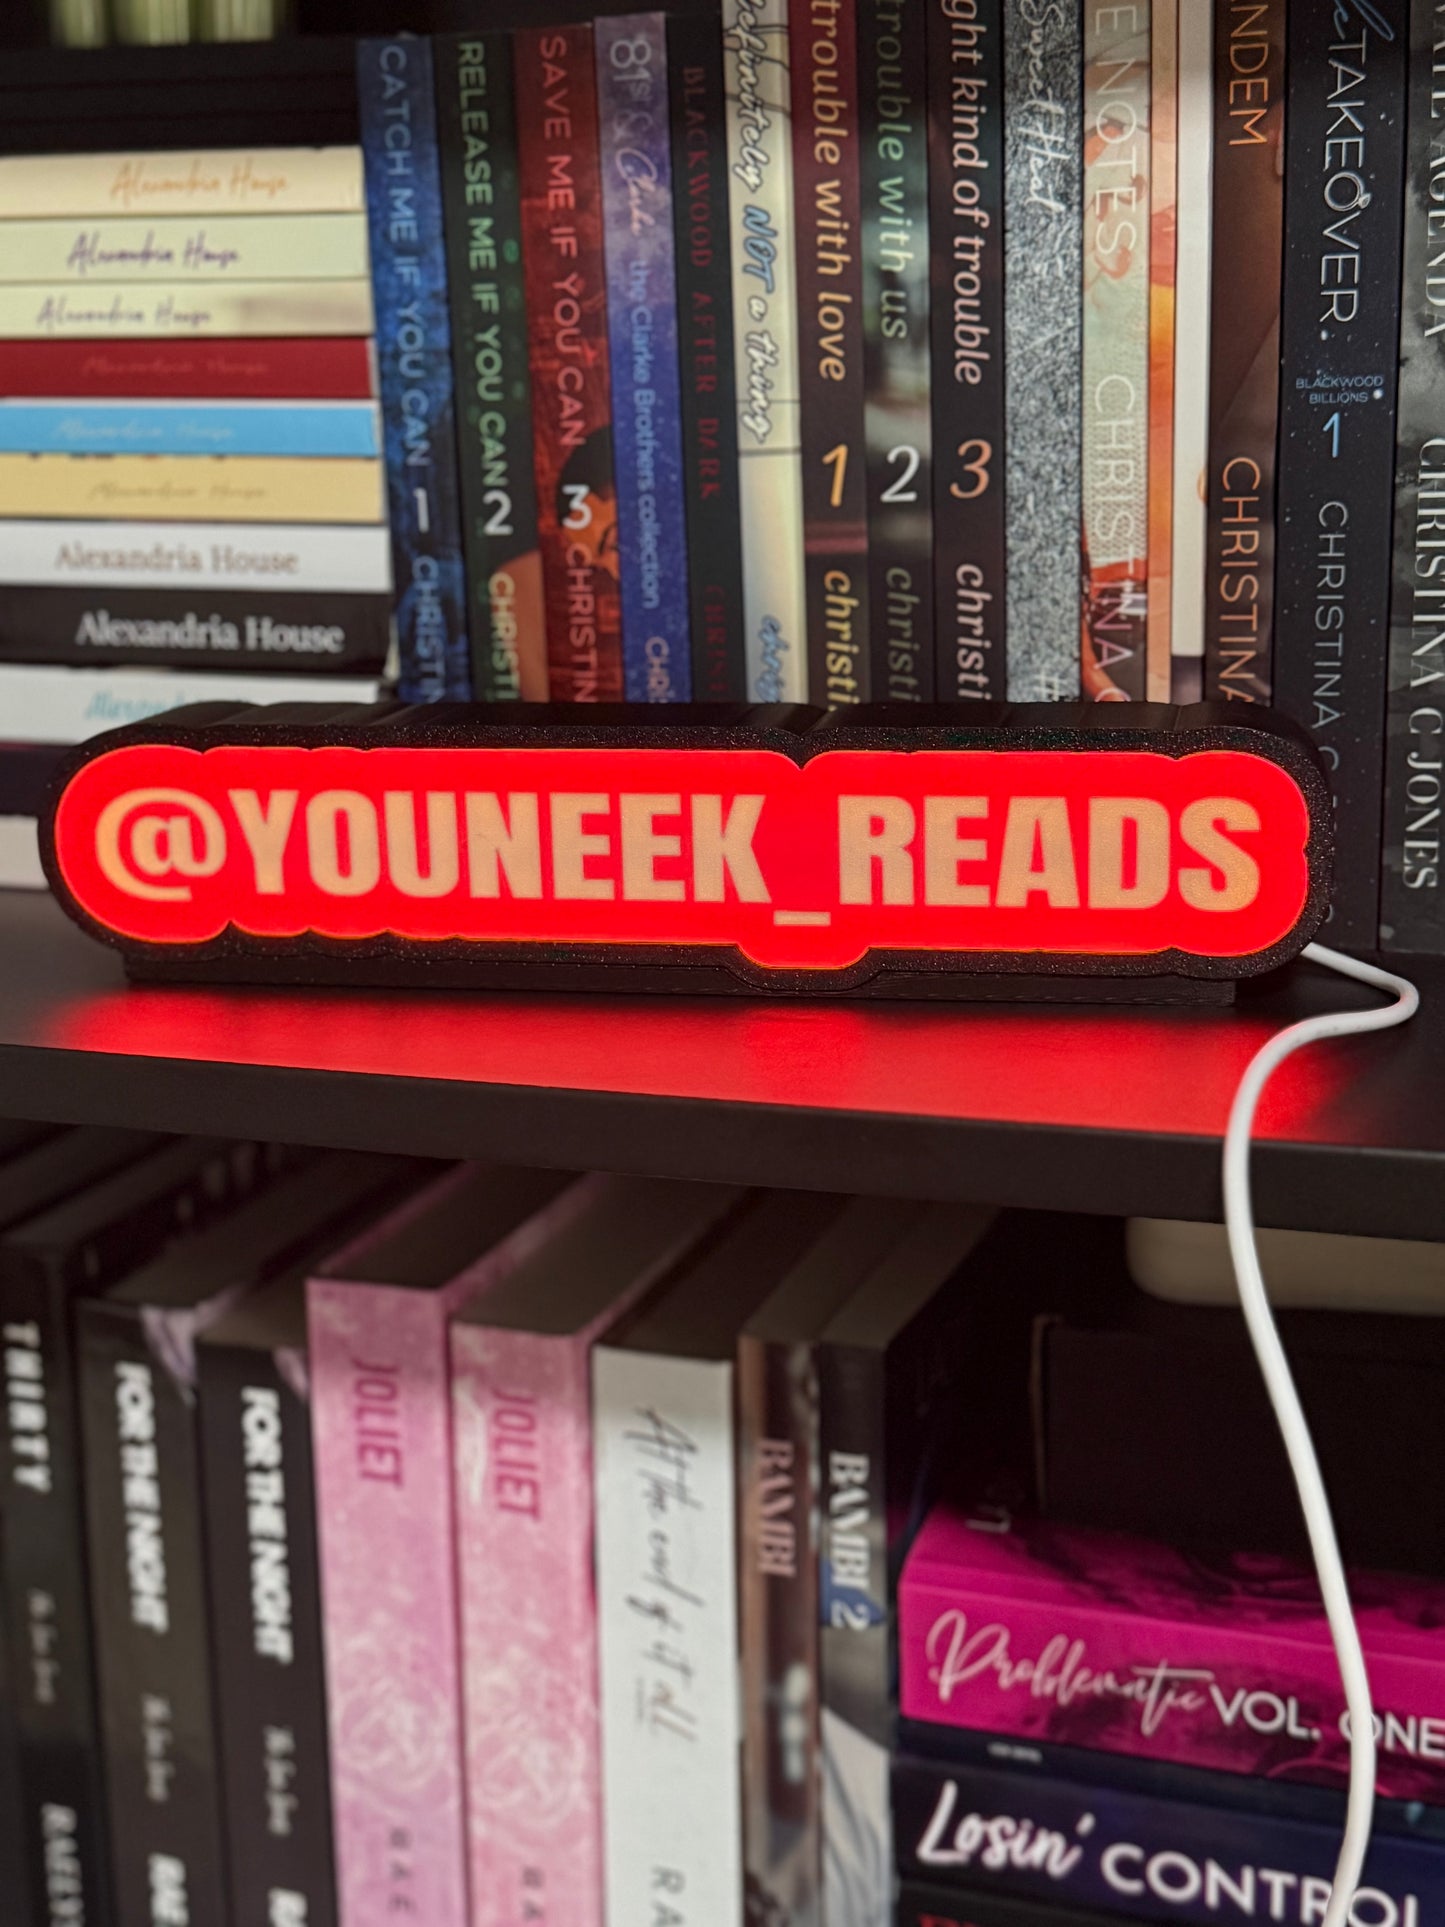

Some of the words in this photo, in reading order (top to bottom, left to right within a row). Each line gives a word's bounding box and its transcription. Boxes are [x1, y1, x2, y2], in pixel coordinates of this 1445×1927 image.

[540, 35, 572, 140] SAVE
[811, 0, 849, 165] trouble
[1019, 0, 1066, 114] Sweet
[1229, 0, 1269, 147] NDEM
[378, 45, 414, 176] CATCH
[458, 40, 494, 207] RELEASE
[952, 76, 990, 170] kind
[547, 155, 577, 211] ME
[683, 66, 714, 268] BLACKWOOD
[1095, 57, 1138, 256] NOTES
[1320, 28, 1373, 324] TAKEOVER
[386, 187, 418, 243] ME
[551, 226, 578, 258] IF
[816, 179, 852, 276] with
[878, 177, 916, 273] with
[953, 179, 991, 230] of
[393, 255, 422, 287] IF
[468, 216, 498, 272] ME
[471, 282, 499, 315] IF
[553, 272, 583, 355] YOU
[817, 291, 854, 382] love
[881, 291, 908, 340] us
[953, 234, 992, 386] trouble
[396, 301, 427, 378] YOU
[475, 324, 505, 402] YOU
[557, 366, 587, 447] CAN
[1295, 375, 1385, 389] BLACKWOOD
[1309, 392, 1369, 404] BILLIONS
[401, 388, 431, 467] CAN
[479, 411, 510, 488] CAN
[1322, 412, 1340, 458] 1
[562, 484, 593, 530] 3
[821, 443, 849, 508] 1
[880, 445, 921, 503] 2
[949, 438, 993, 499] 3
[412, 486, 430, 534] 1
[483, 490, 514, 536] 2
[1409, 437, 1445, 689] CHRISTINA
[75, 608, 239, 649] Alexandria
[245, 615, 346, 654] House
[1311, 501, 1349, 729] CHRISTINA
[1409, 707, 1444, 735] C
[95, 786, 1263, 927] @YOUNEEK_READS
[1403, 751, 1443, 889] JONES
[830, 1599, 871, 1632] 2
[1209, 1684, 1322, 1741] VOL.
